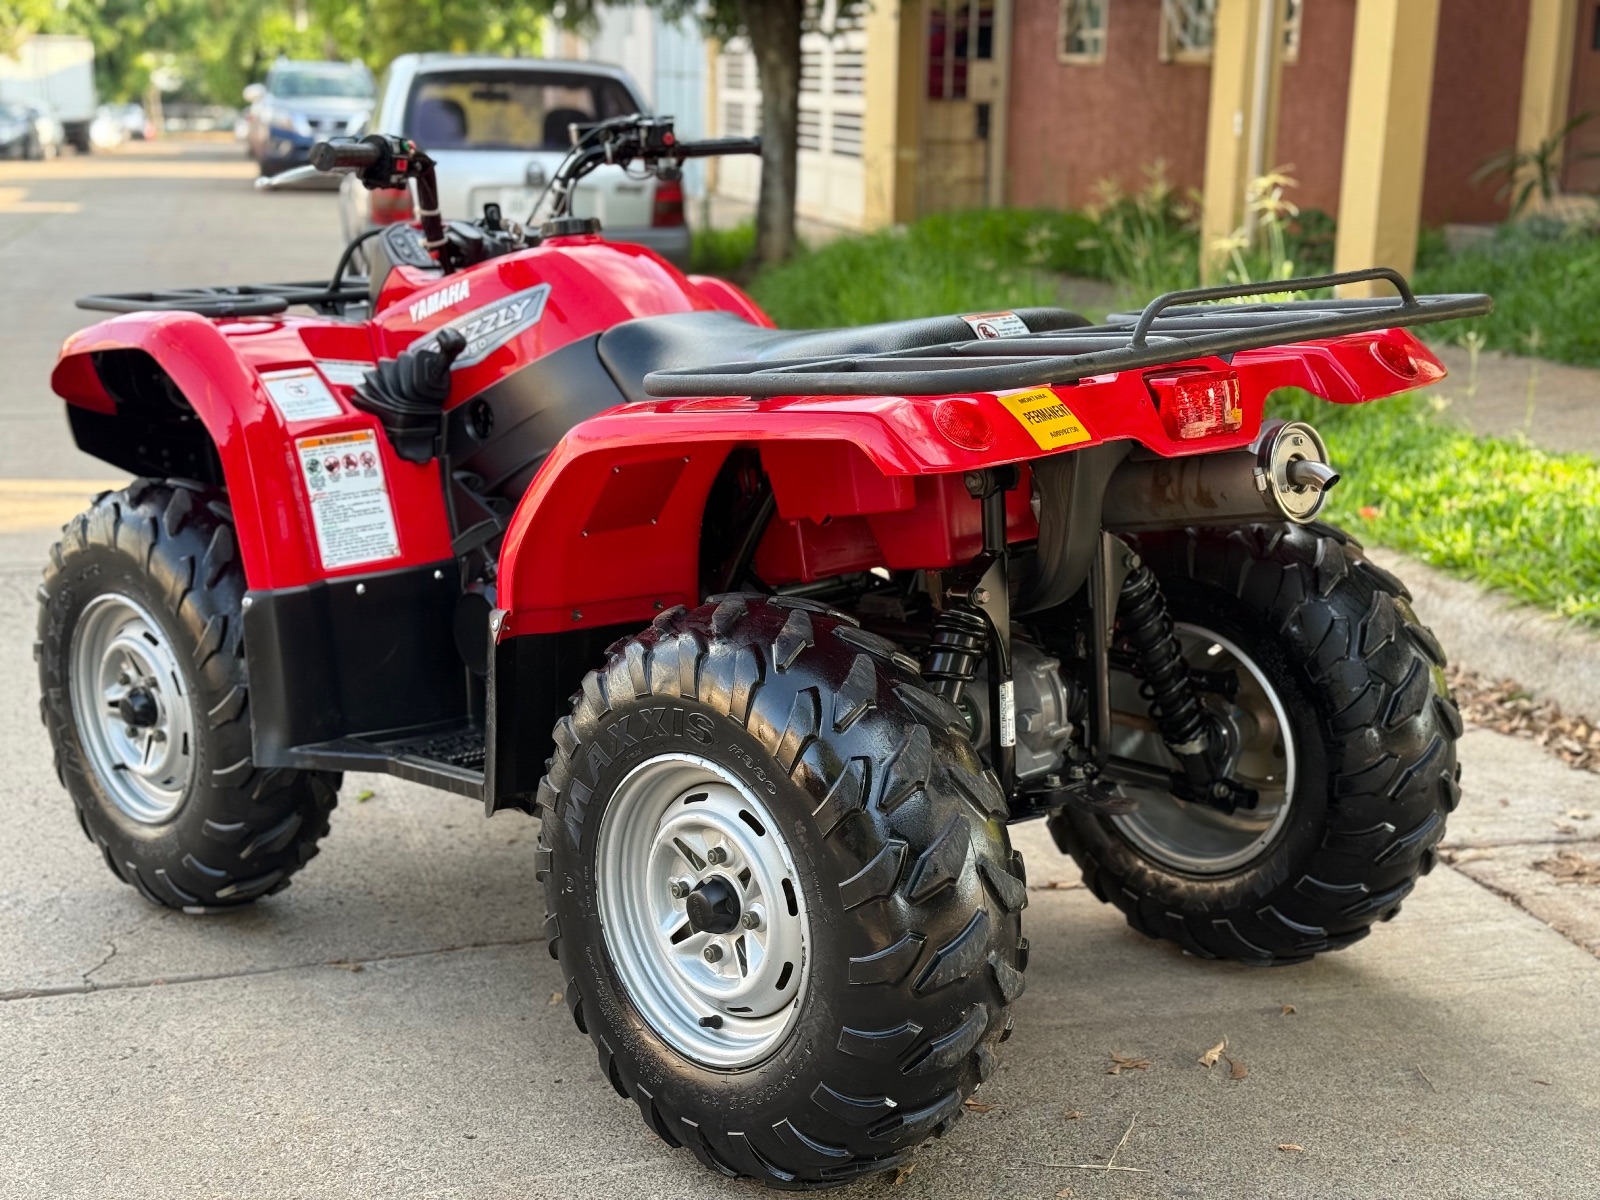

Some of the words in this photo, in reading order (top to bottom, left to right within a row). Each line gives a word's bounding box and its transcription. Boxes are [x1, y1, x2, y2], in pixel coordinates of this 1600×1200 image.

[409, 279, 470, 323] YAMAHA
[1017, 393, 1048, 405] MONTANA
[1022, 403, 1072, 425] PERMANENT
[563, 706, 716, 852] MAXXIS
